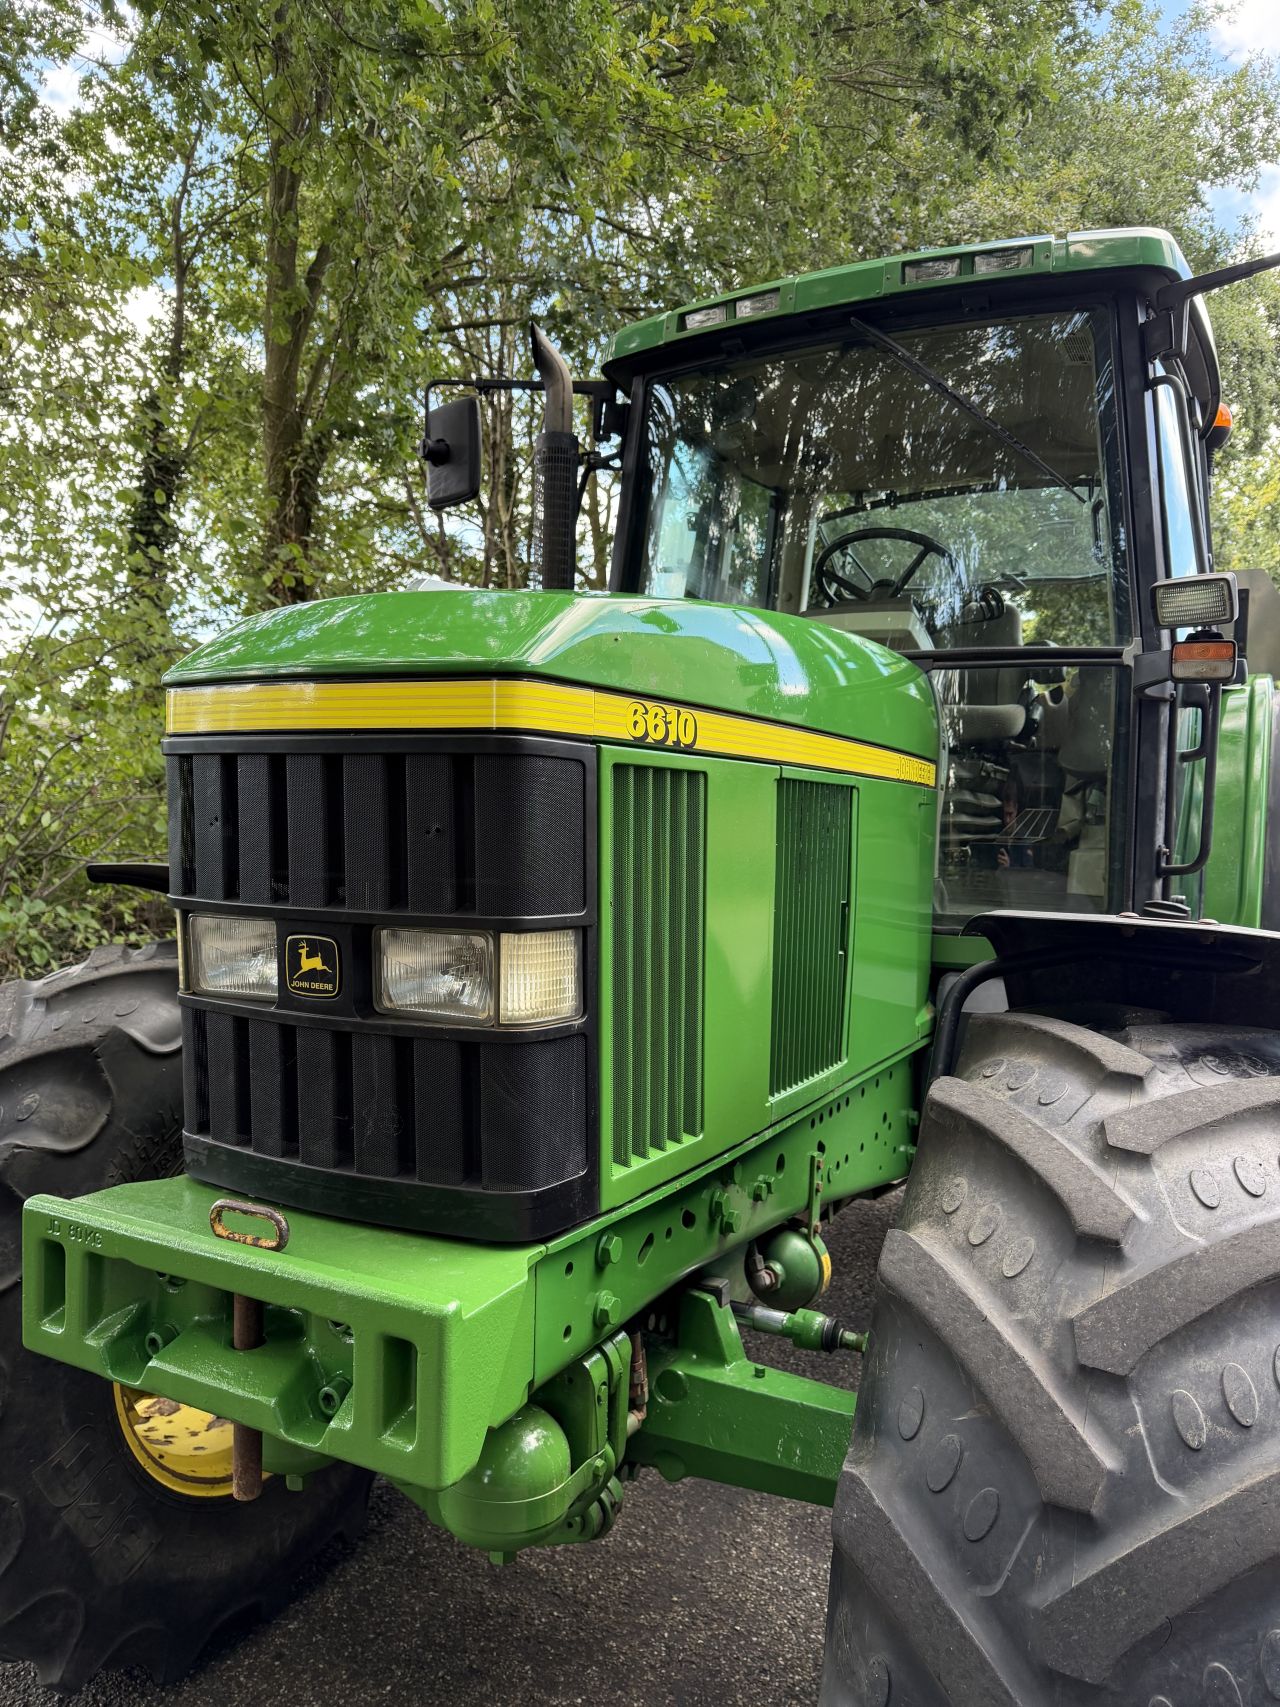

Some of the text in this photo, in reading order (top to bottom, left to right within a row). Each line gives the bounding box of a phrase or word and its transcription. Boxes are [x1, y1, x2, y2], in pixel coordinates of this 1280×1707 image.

[626, 702, 698, 748] 6610
[291, 980, 334, 991] JOHN DEERE
[47, 1219, 60, 1236] JD
